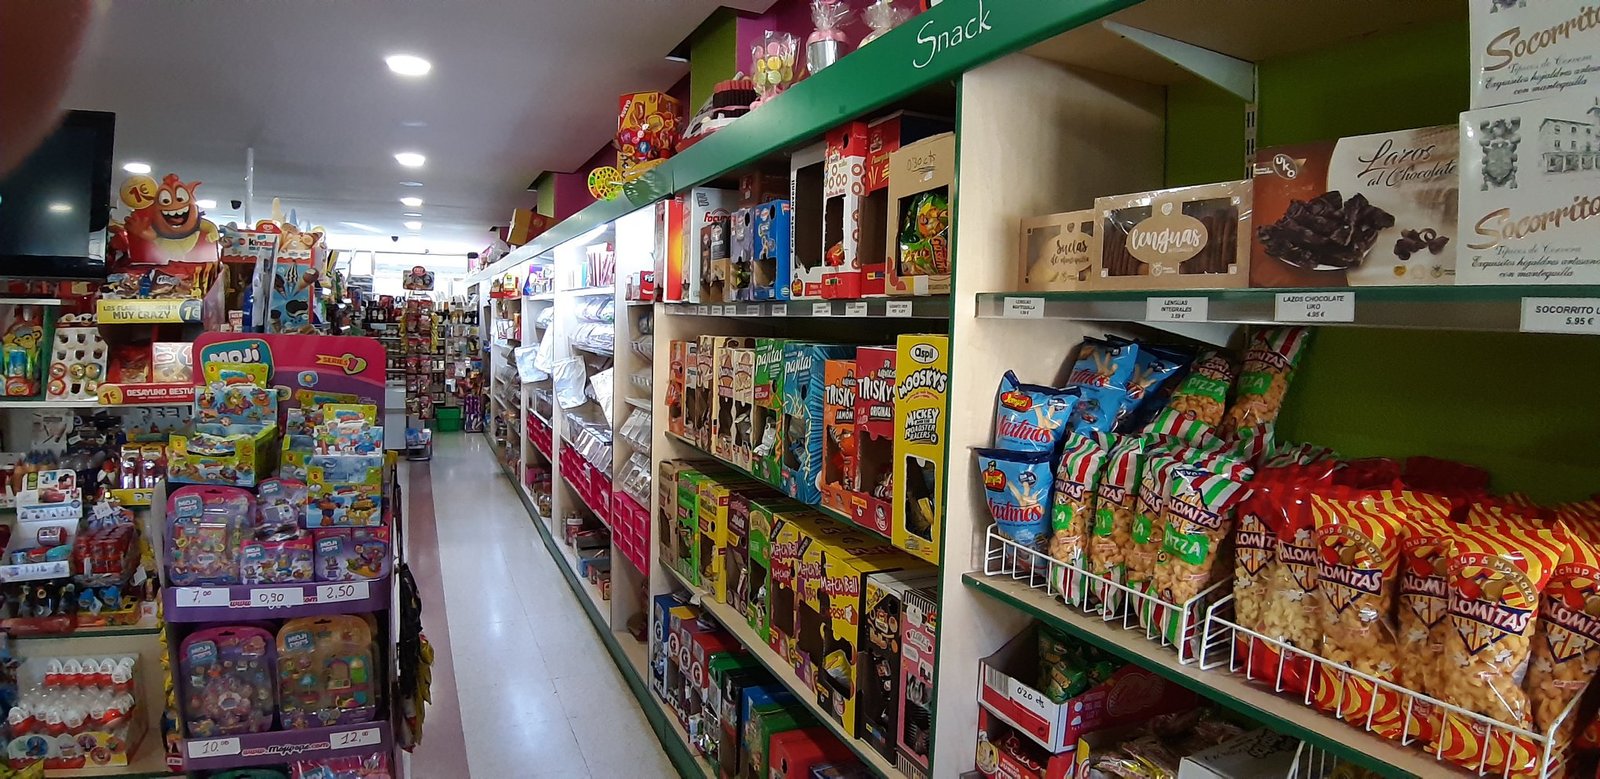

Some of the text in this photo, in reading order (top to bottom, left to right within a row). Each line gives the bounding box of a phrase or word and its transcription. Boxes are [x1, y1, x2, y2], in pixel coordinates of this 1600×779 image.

[913, 0, 992, 68] Snack
[1357, 139, 1436, 178] Lazos
[1367, 170, 1386, 187] al
[1056, 239, 1088, 255] Suelas
[1132, 228, 1201, 253] lenguas
[112, 311, 134, 320] MUY
[137, 311, 171, 320] CRAZY
[1535, 305, 1595, 315] SOCORRITO
[1565, 316, 1594, 326] 5.95 €
[897, 367, 947, 399] MOOSKYS
[1187, 376, 1225, 397] PIZZA
[825, 384, 856, 408] TRISKY
[1168, 498, 1223, 529] ALOMITAS
[1164, 529, 1202, 557] PIZZA
[1318, 558, 1383, 592] LOMITAS
[1452, 598, 1530, 633] LOMITAS
